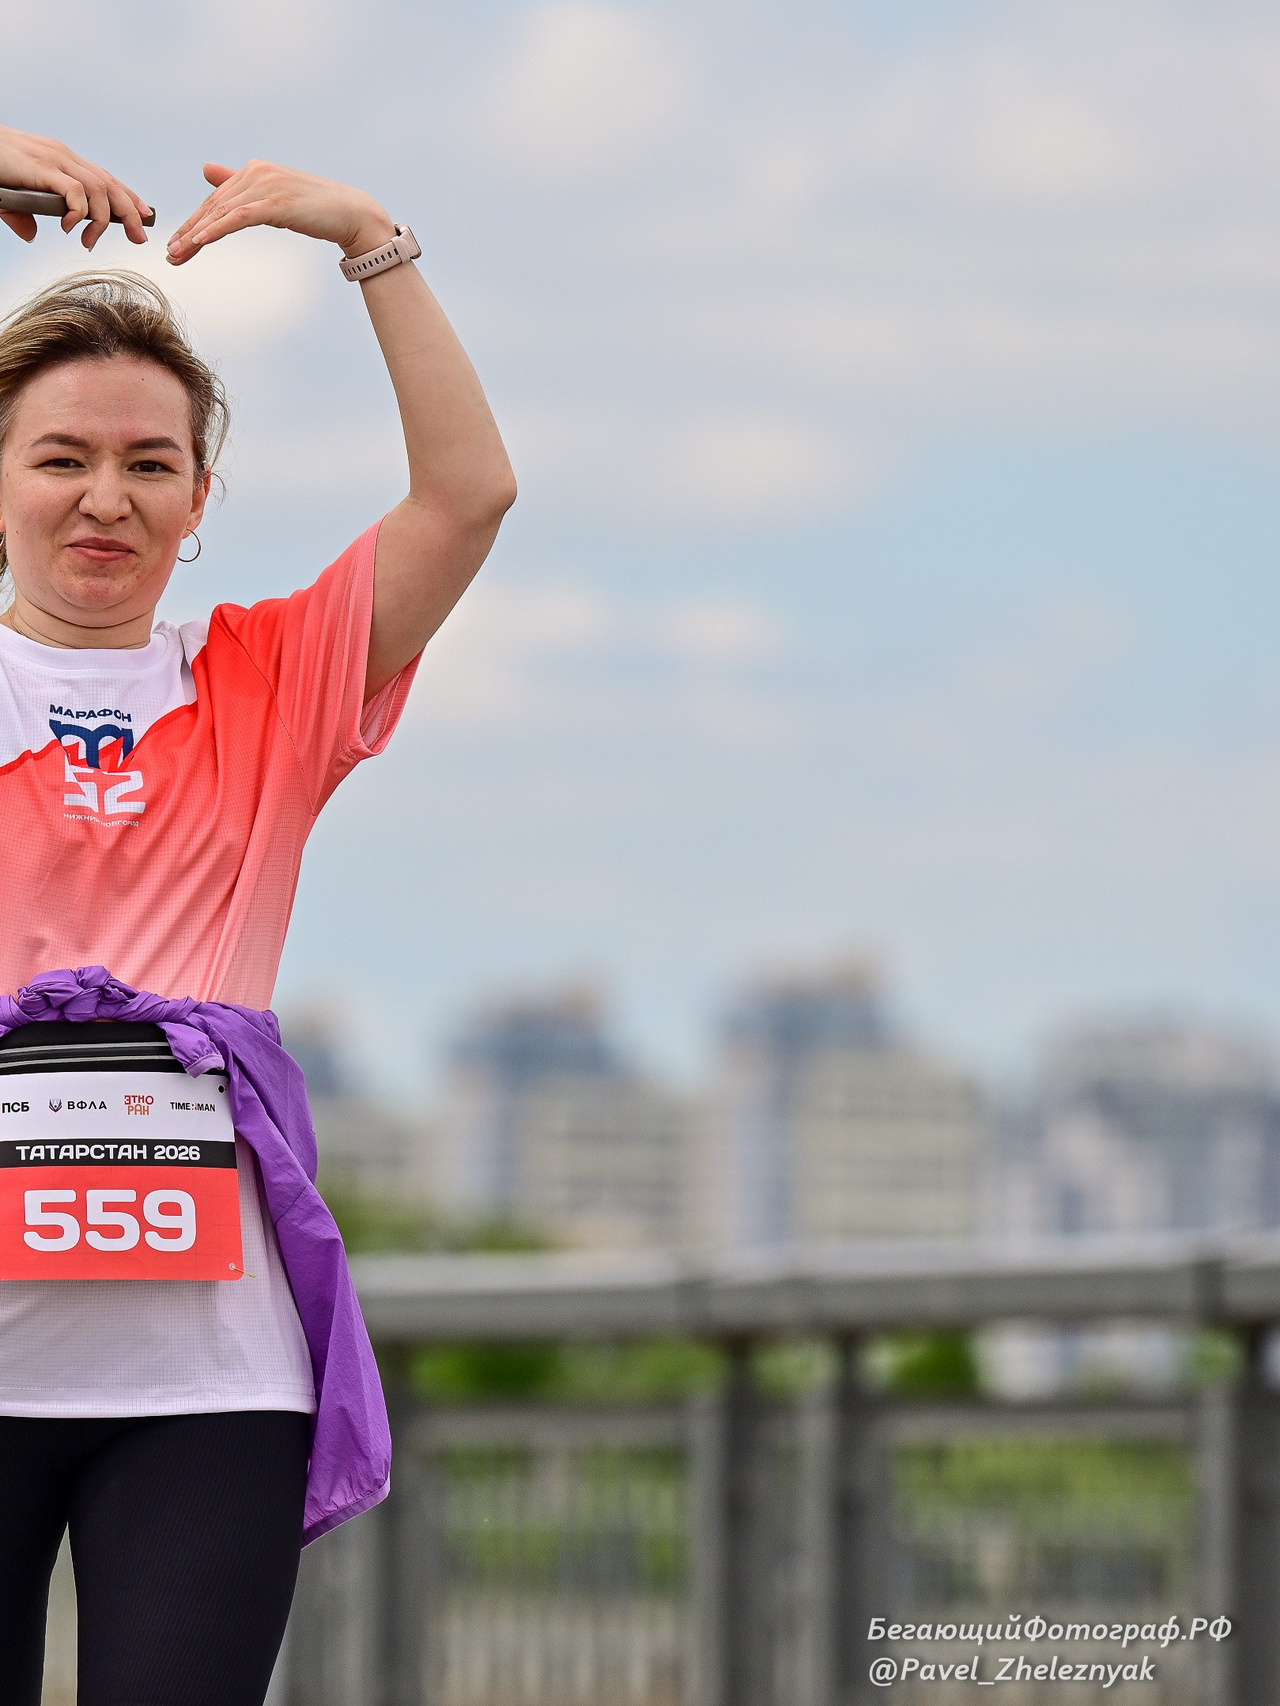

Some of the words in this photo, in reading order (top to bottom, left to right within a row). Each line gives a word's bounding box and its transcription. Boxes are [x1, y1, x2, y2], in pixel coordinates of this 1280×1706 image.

[49, 704, 132, 722] МАРАФОН
[63, 754, 147, 815] 52
[1, 1101, 30, 1114] ПСБ
[67, 1100, 108, 1110] ВФЛА
[124, 1094, 154, 1106] ЭТНО
[127, 1104, 150, 1116] РАН
[15, 1144, 147, 1161] ТАТАРСТАН
[153, 1145, 201, 1161] 2026
[23, 1189, 197, 1252] 559
